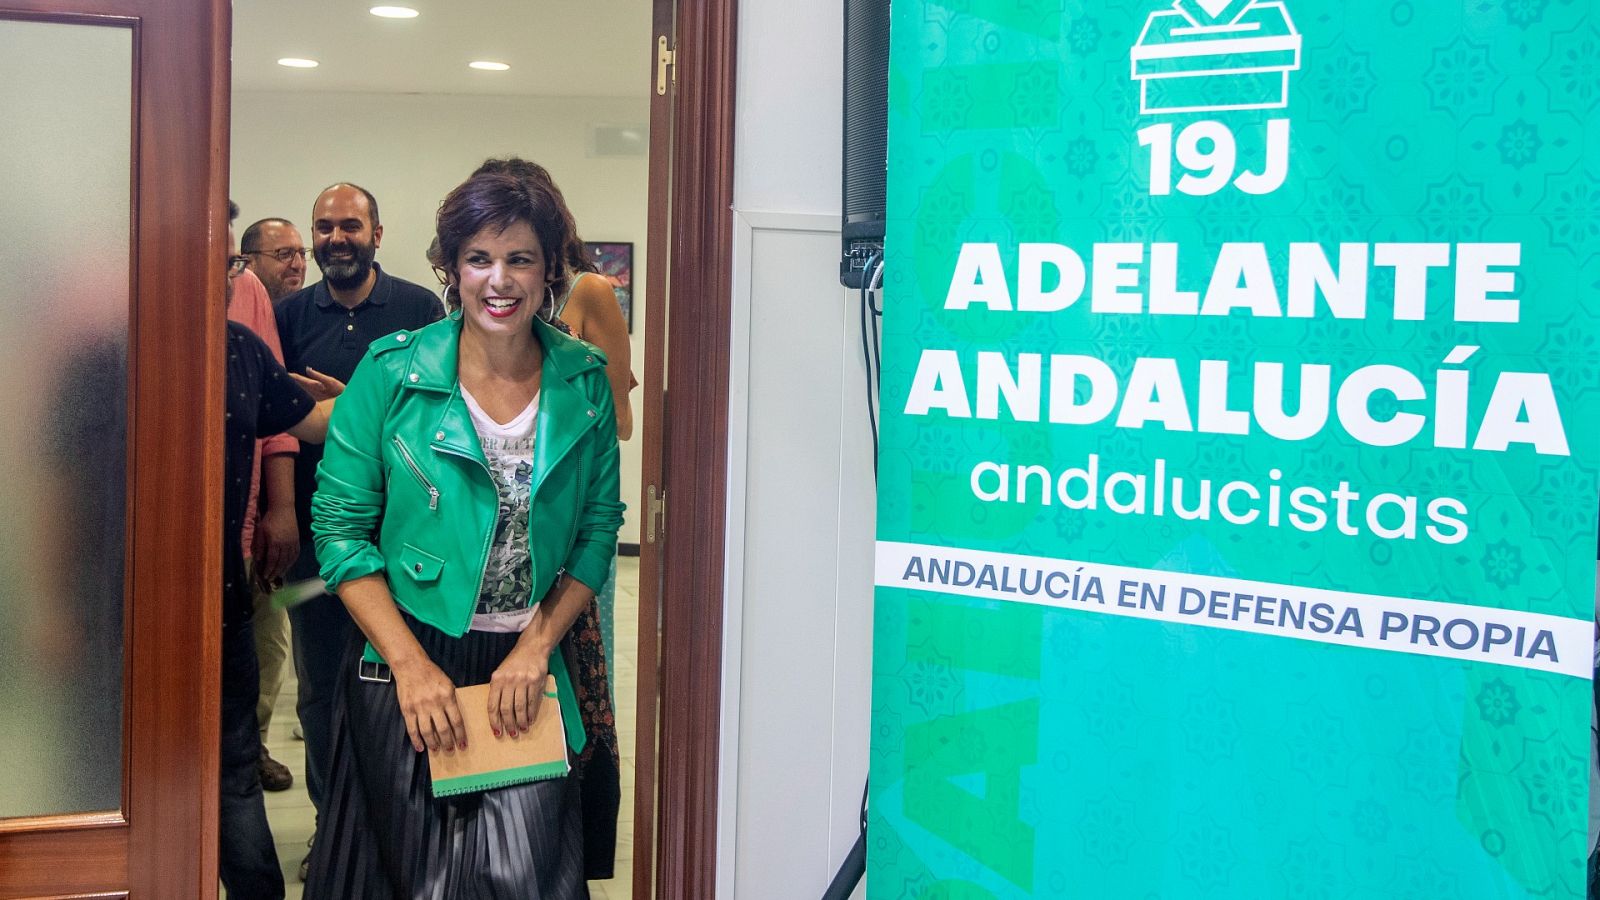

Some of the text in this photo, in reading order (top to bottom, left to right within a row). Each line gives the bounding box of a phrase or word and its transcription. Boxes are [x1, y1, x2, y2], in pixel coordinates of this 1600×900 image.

[1136, 118, 1291, 197] 19J
[943, 242, 1521, 323] ADELANTE
[904, 345, 1571, 456] ANDALUCÍA
[970, 453, 1469, 545] andalucistas
[902, 556, 1559, 663] ANDALUCÍA EN DEFENSA PROPIA
